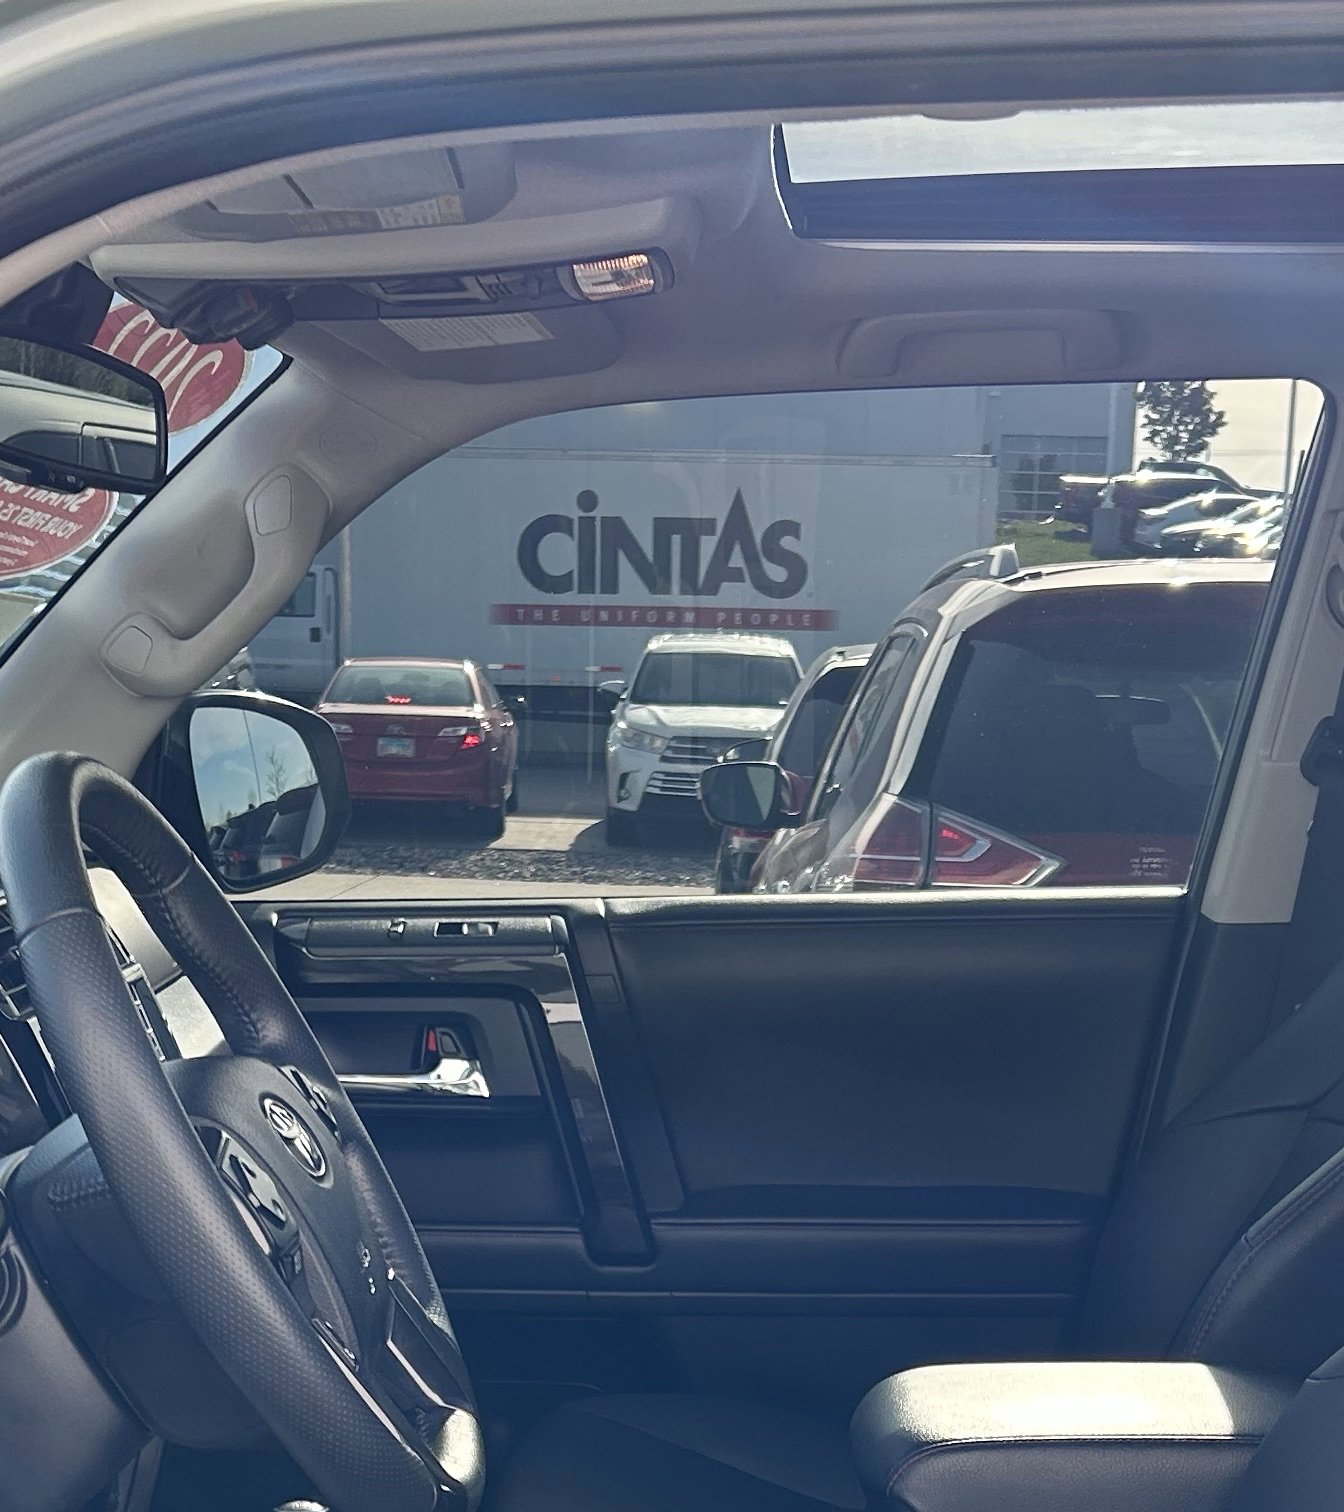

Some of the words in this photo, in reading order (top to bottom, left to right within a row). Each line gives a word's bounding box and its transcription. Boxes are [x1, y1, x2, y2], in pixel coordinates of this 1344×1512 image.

[515, 608, 561, 622] THE
[580, 609, 697, 624] UNIFORM
[716, 612, 812, 627] PEOPLE
